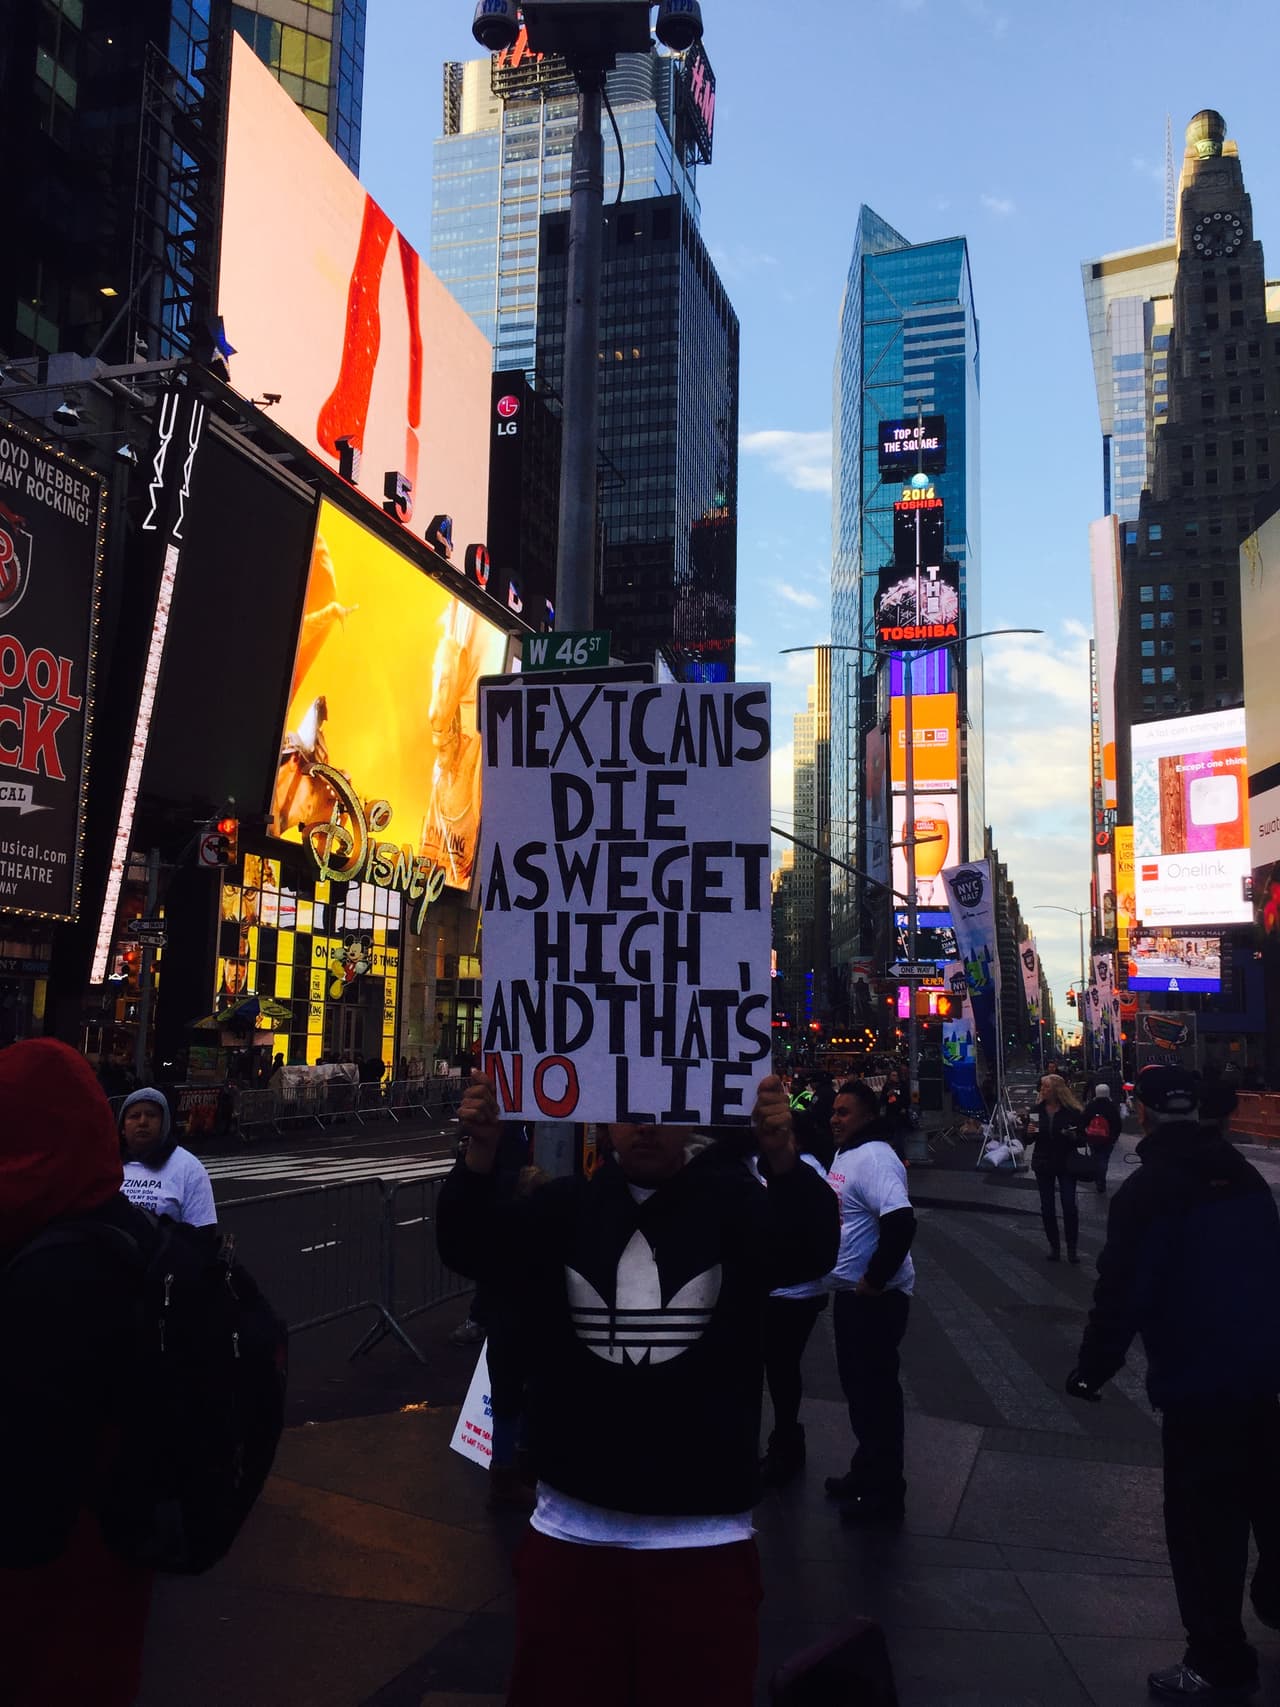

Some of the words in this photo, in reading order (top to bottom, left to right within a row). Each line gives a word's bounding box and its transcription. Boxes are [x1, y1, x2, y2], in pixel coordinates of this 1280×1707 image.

[497, 421, 517, 436] LG
[893, 428, 911, 440] TOP
[913, 427, 925, 438] OF
[884, 441, 901, 453] THE
[34, 456, 90, 505] WEBBER
[26, 475, 89, 526] ROCKING!
[902, 487, 935, 502] 2016
[894, 498, 943, 511] TOSHIBA
[880, 623, 957, 640] TOSHIBA
[530, 638, 549, 665] W
[486, 685, 771, 768] MEXICANS
[1176, 761, 1206, 773] Except
[550, 769, 687, 841] DIE
[1, 840, 67, 865] usical.com
[0, 861, 53, 884] THEATRE
[957, 880, 979, 895] NYC
[960, 891, 979, 903] HALF
[534, 912, 701, 985] HIGH
[380, 955, 399, 967] TMES
[901, 966, 914, 974] ONE
[917, 966, 931, 974] WAY
[483, 979, 594, 1054] AND
[484, 1052, 580, 1118] NO
[616, 1056, 752, 1126] LIE
